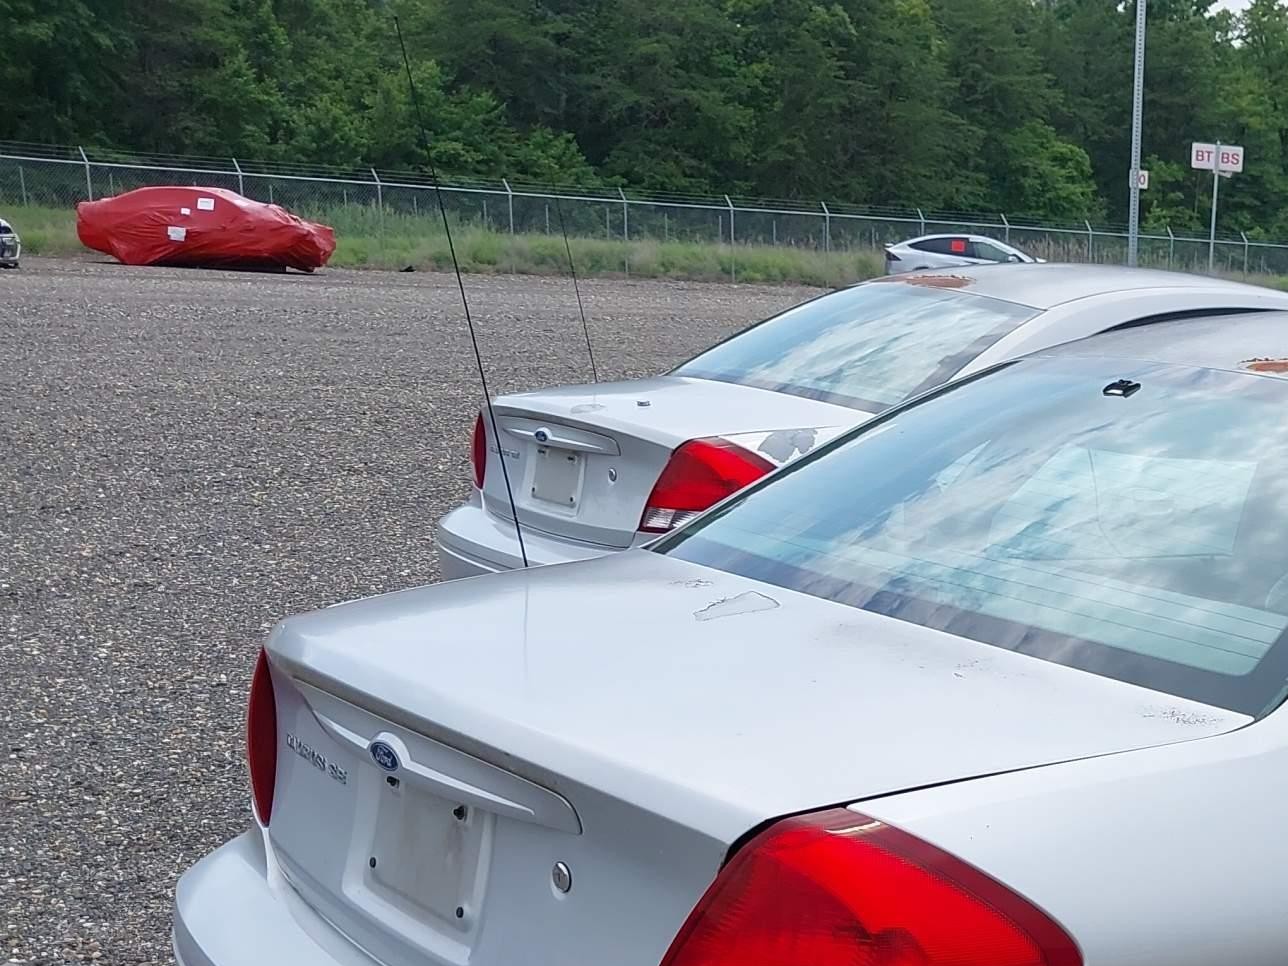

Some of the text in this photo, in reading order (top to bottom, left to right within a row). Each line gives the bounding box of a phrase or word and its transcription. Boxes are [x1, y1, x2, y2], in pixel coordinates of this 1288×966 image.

[1195, 149, 1240, 165] BT BS
[375, 744, 393, 767] Ford
